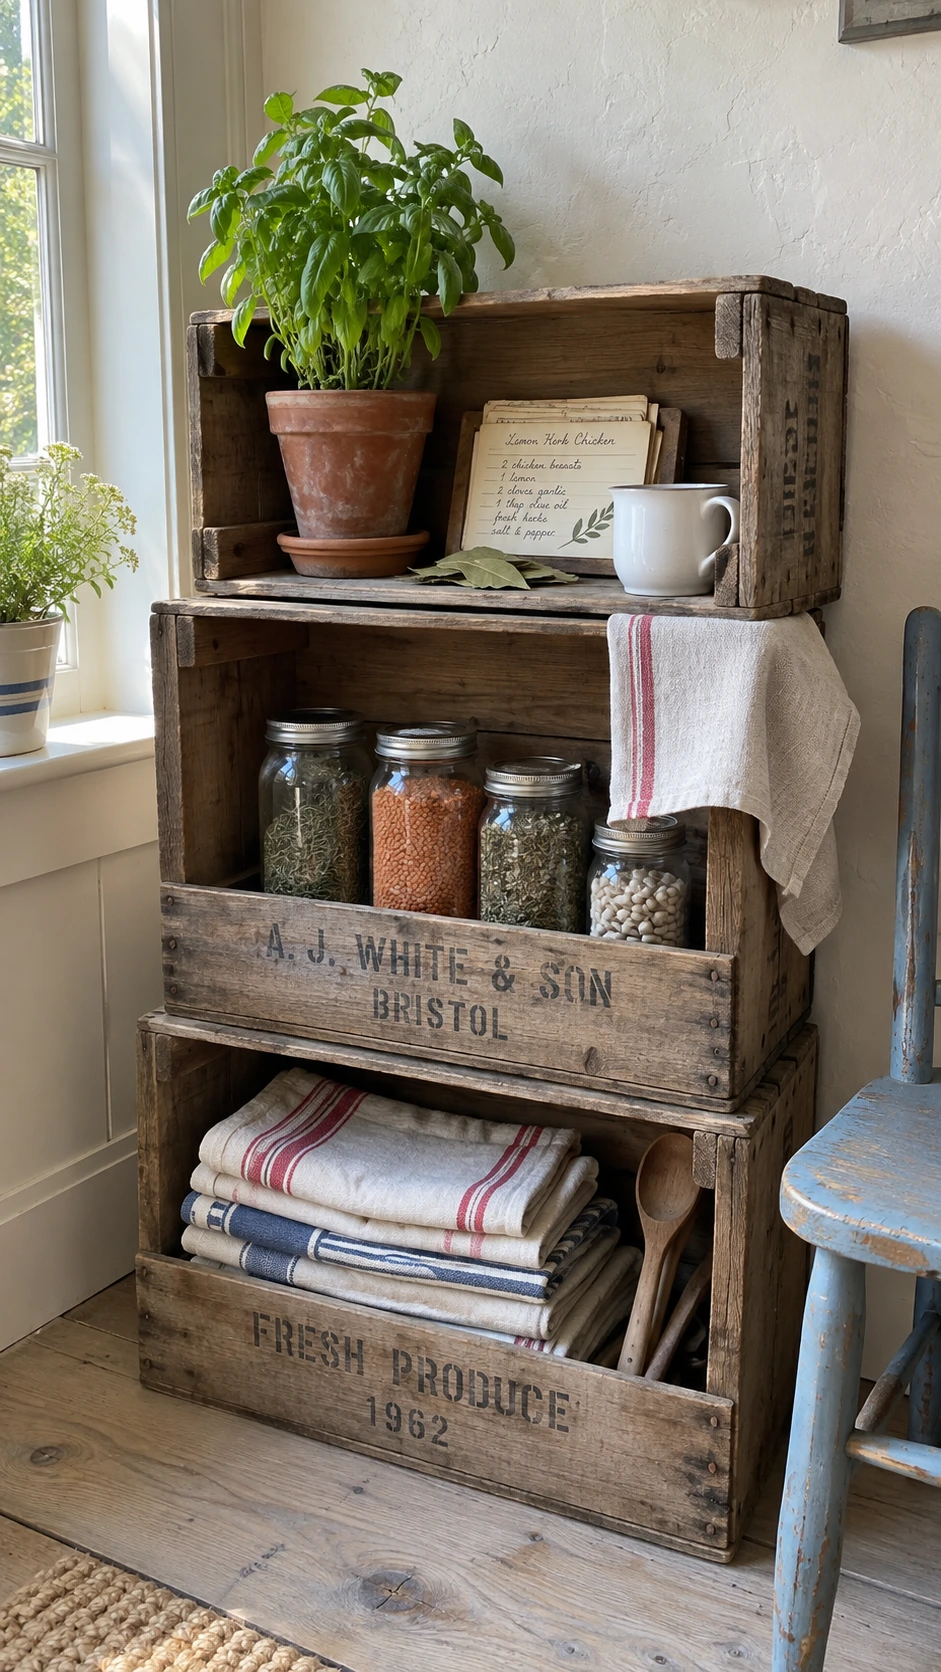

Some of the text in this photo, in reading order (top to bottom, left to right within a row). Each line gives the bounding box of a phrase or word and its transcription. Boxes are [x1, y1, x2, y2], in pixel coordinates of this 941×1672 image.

[505, 432, 539, 446] Lemon
[574, 432, 616, 446] Chicken
[501, 459, 508, 469] 2
[511, 459, 546, 470] chicken
[501, 472, 536, 482] 1 lemon
[497, 485, 503, 495] 2
[496, 499, 502, 508] 1
[491, 525, 511, 536] salt
[266, 923, 612, 1008] A. J. WHITE & SON
[373, 988, 509, 1041] BRISTOL
[252, 1311, 570, 1433] FRESH PRODUCE
[366, 1396, 449, 1448] 1962
